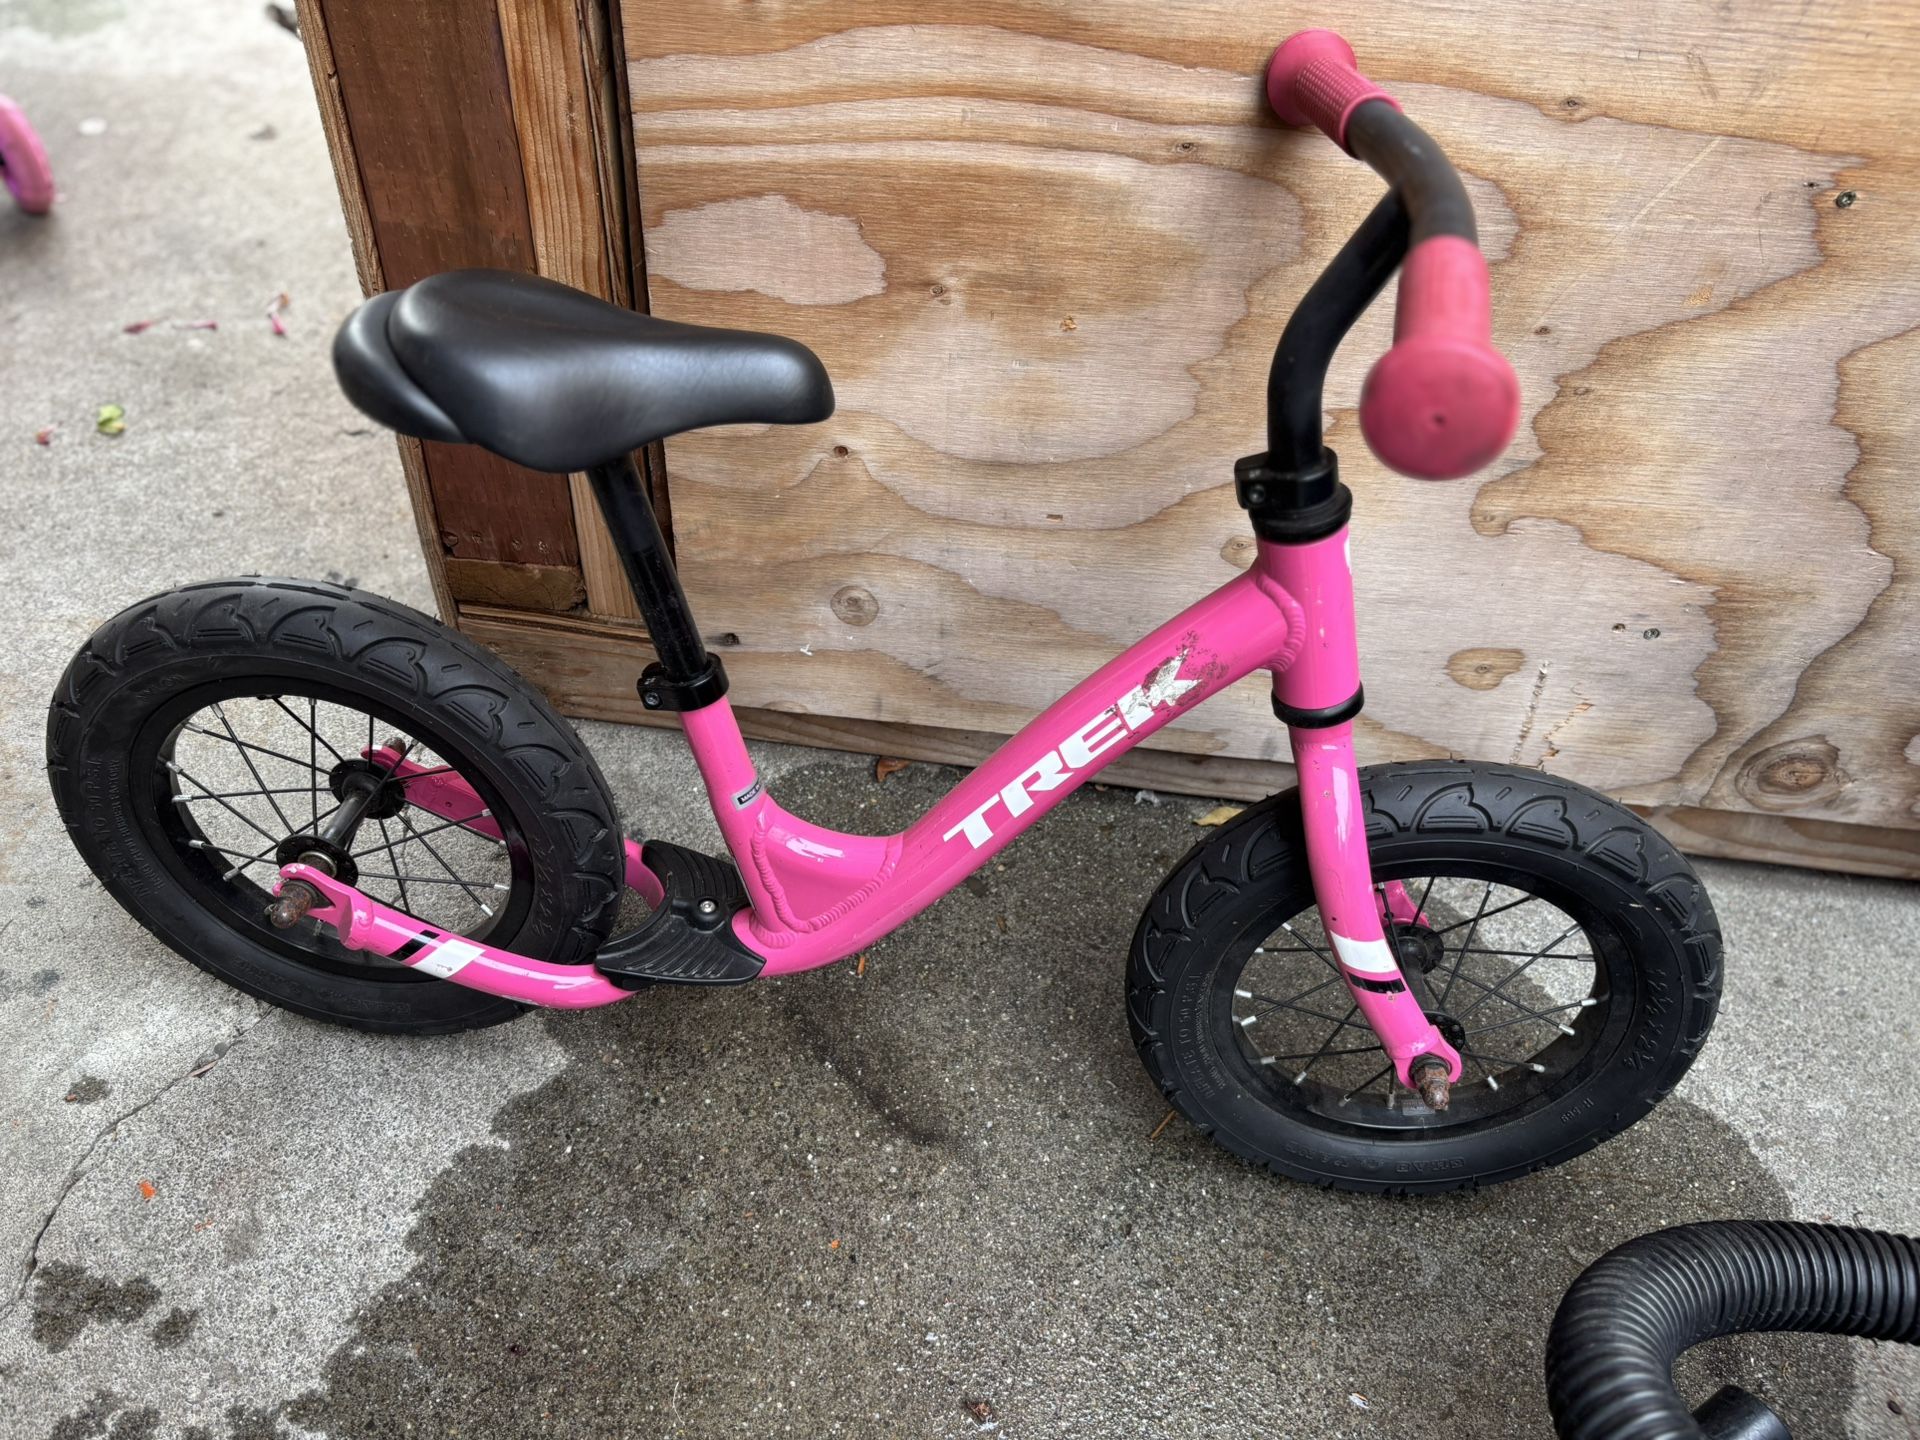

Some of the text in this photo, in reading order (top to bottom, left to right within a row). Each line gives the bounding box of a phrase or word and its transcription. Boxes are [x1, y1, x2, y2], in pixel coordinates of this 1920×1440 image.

[943, 648, 1203, 848] TREK
[93, 817, 111, 839] TO
[1178, 1028, 1192, 1044] TO
